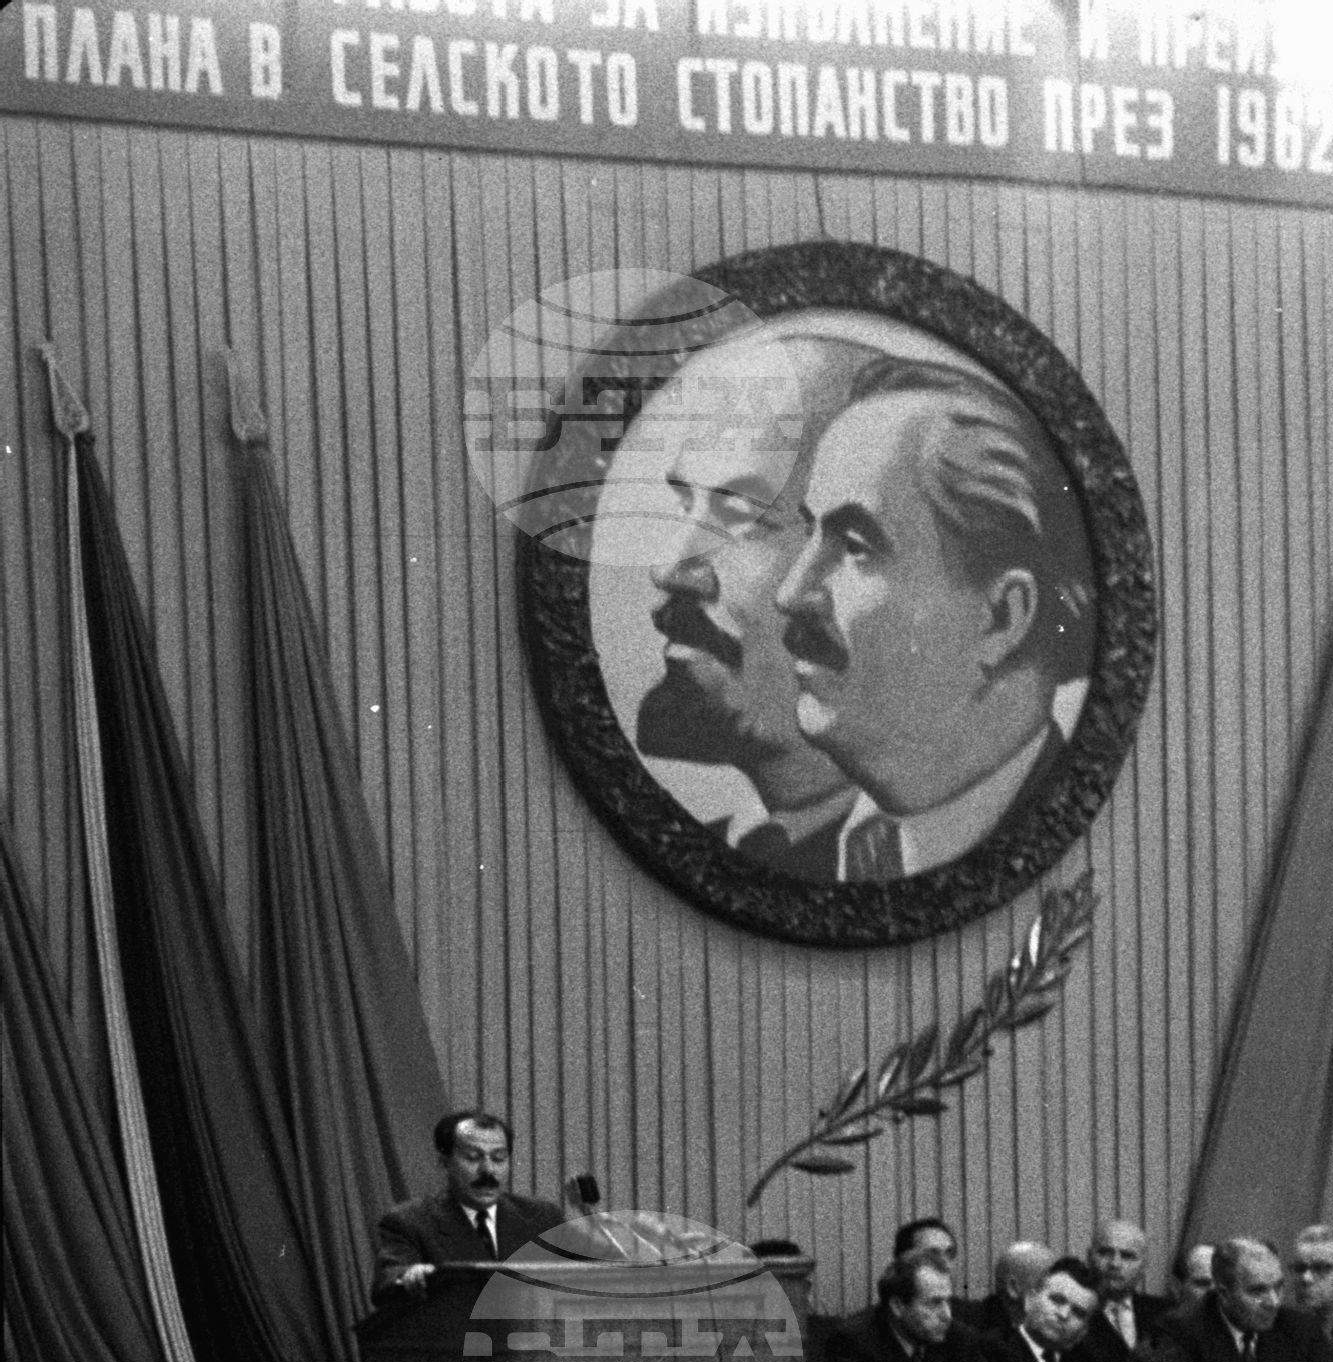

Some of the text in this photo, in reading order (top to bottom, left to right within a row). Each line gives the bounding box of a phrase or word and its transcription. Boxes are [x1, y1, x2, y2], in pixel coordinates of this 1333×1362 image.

[22, 2, 225, 96] ПЛАНА
[248, 22, 283, 100] В
[330, 29, 639, 128] СЕЛСКОТО
[676, 55, 1010, 149] СТОПАНСТВО
[1042, 77, 1175, 162] ПРЕЗ
